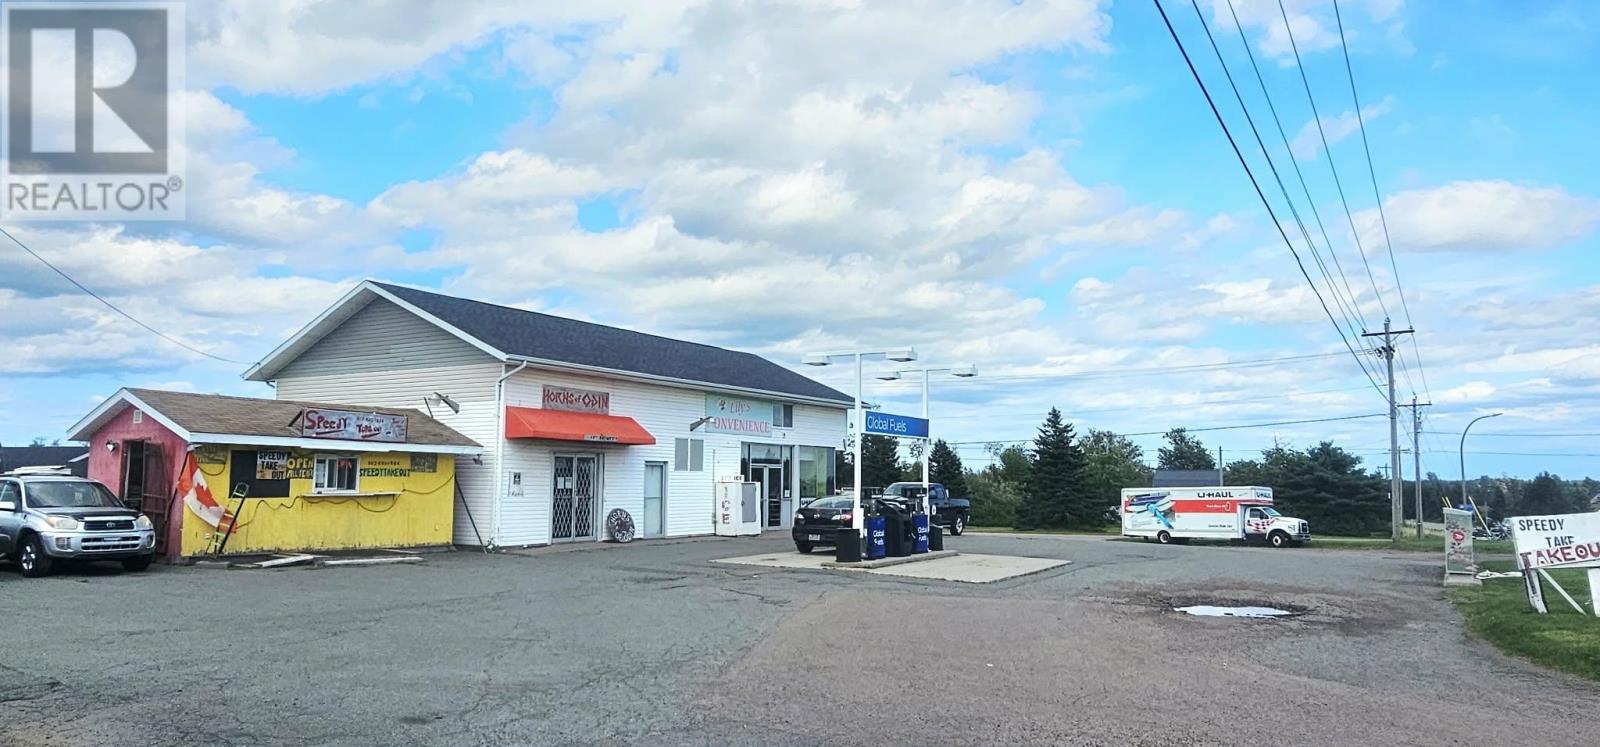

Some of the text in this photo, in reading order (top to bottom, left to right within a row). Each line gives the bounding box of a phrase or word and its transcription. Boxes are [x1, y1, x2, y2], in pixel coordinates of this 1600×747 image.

[543, 388, 574, 405] HORNS
[582, 393, 608, 408] ODIN
[714, 416, 770, 433] ONVENIENCE
[867, 415, 907, 432] Global Fuels
[259, 451, 286, 461] SPEEDY
[261, 460, 279, 470] TAKE
[287, 458, 313, 469] OPEN
[271, 470, 284, 479] OUT
[1518, 518, 1564, 532] SPEEDY
